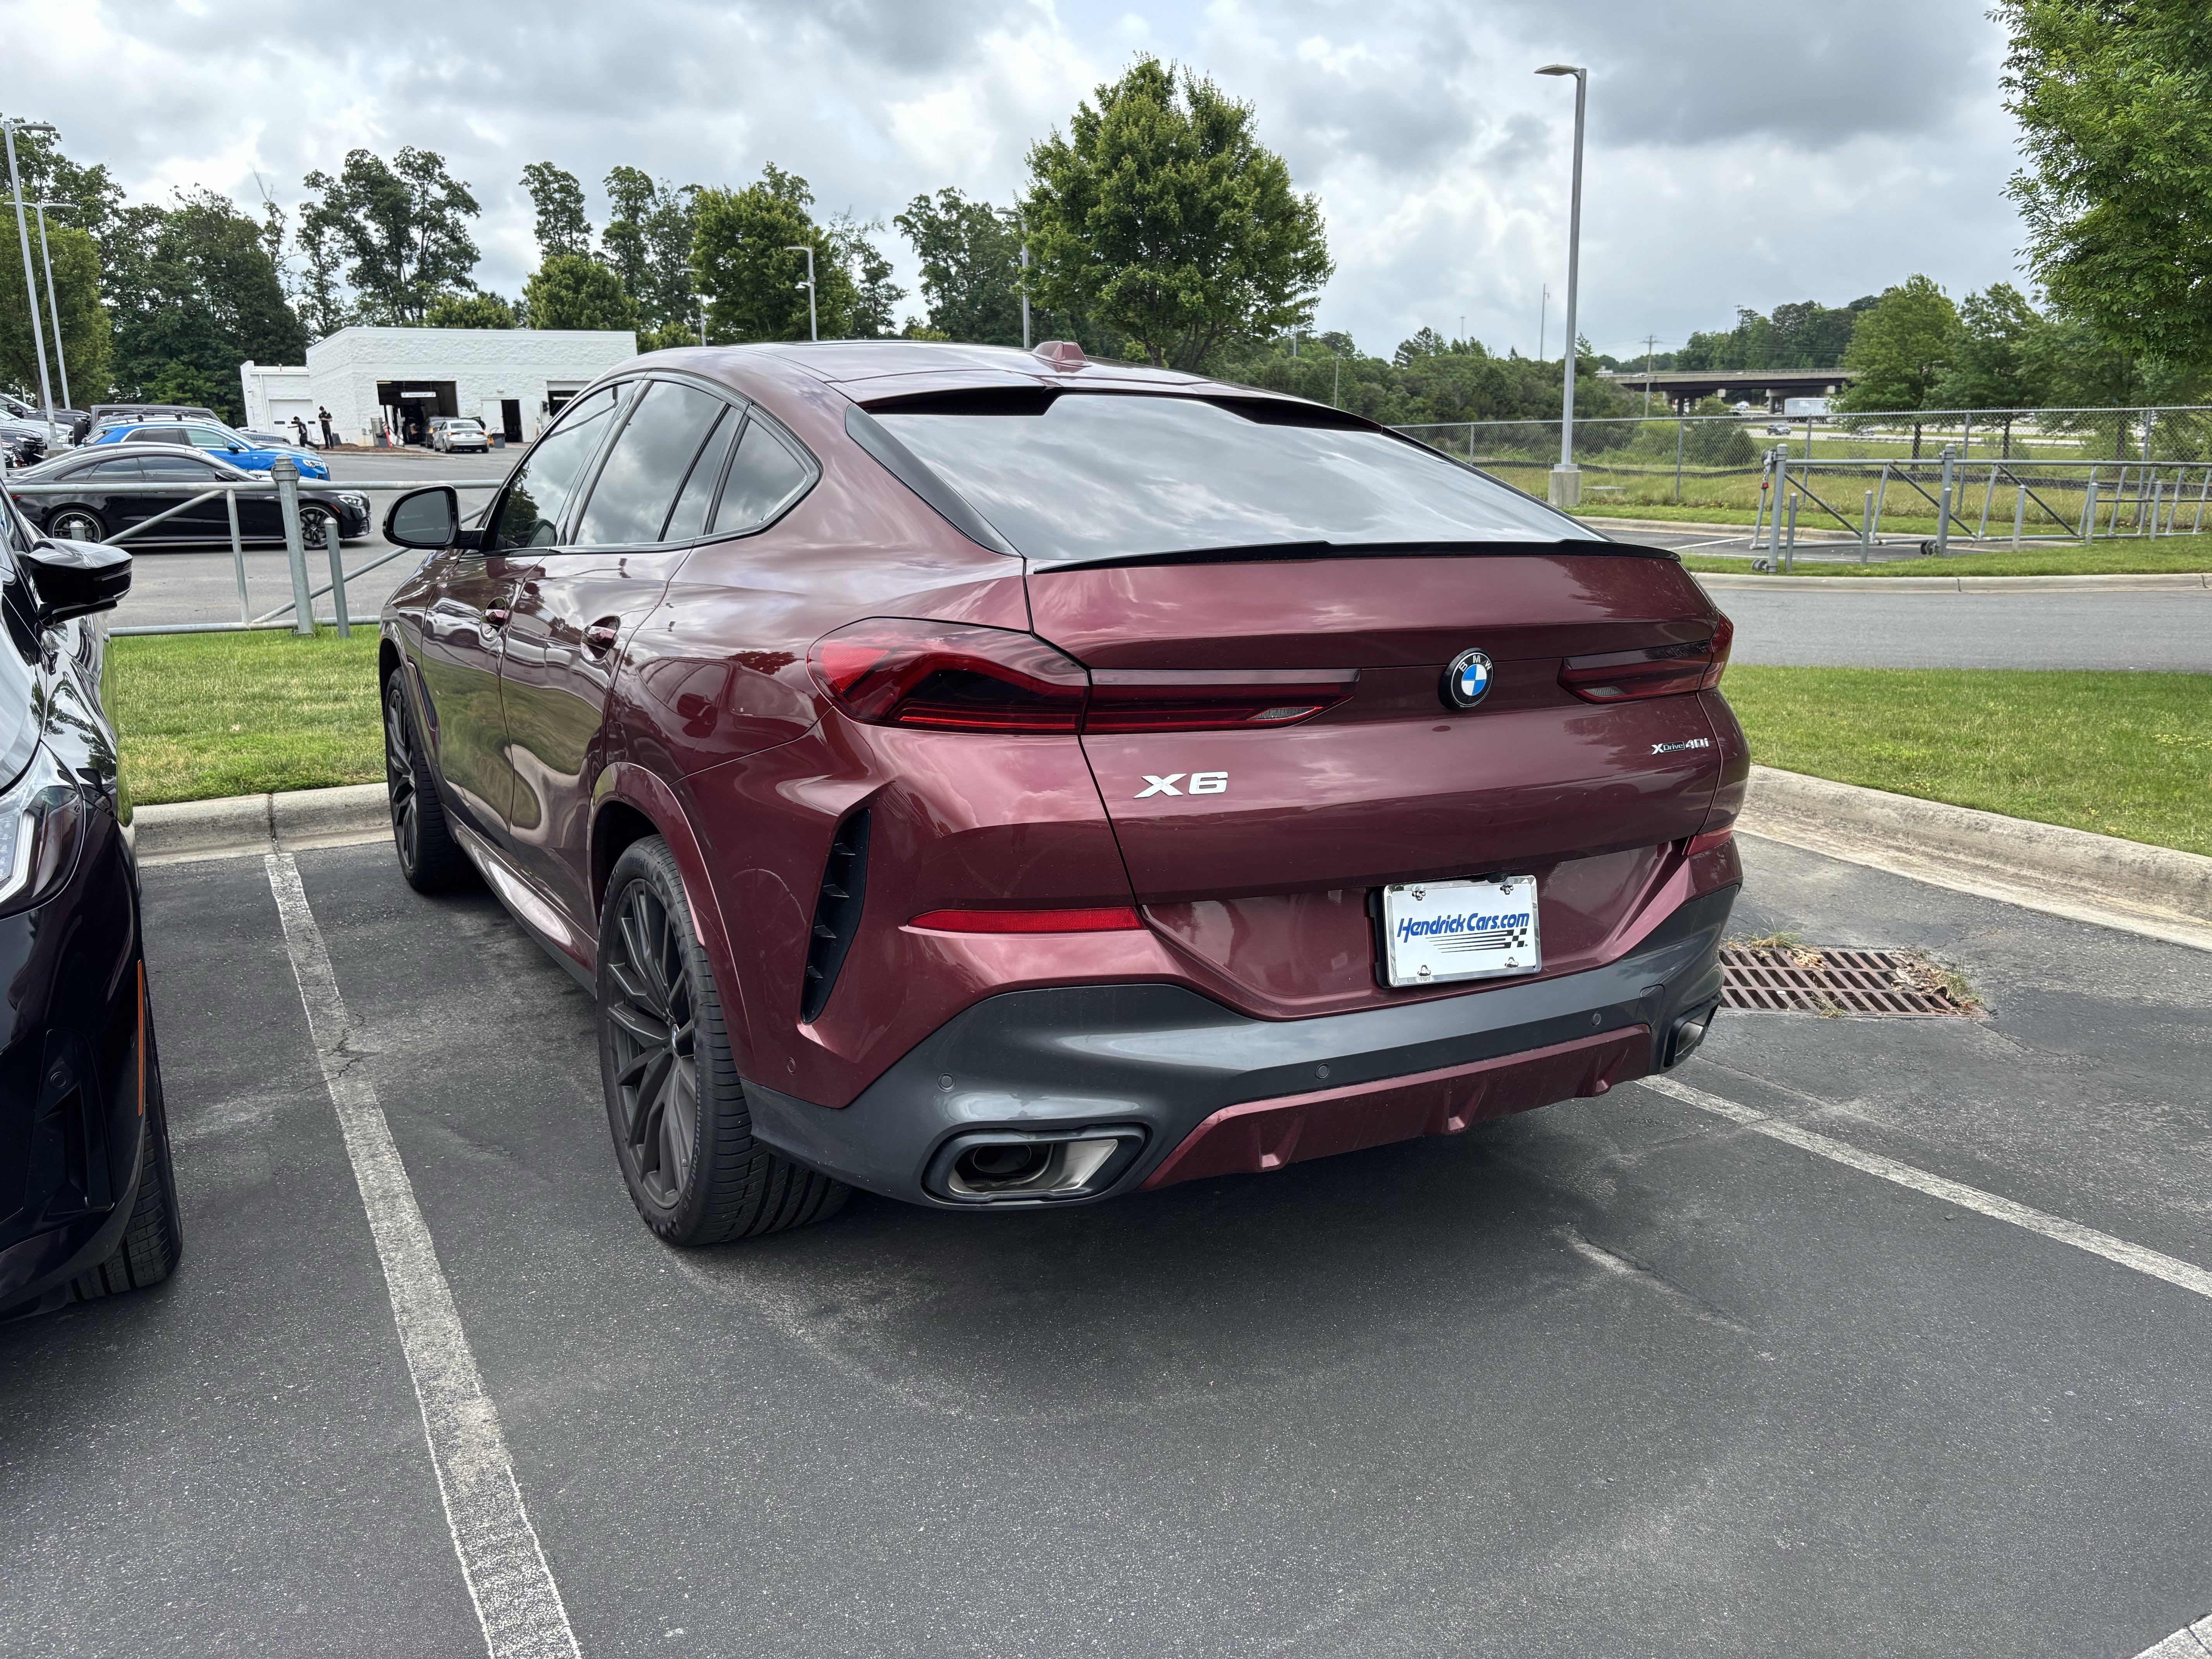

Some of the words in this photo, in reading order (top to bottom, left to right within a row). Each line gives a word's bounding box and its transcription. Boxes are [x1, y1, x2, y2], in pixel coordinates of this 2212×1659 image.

[1459, 655, 1491, 672] BMW
[1686, 738, 1709, 749] 40i
[1133, 771, 1228, 799] X6
